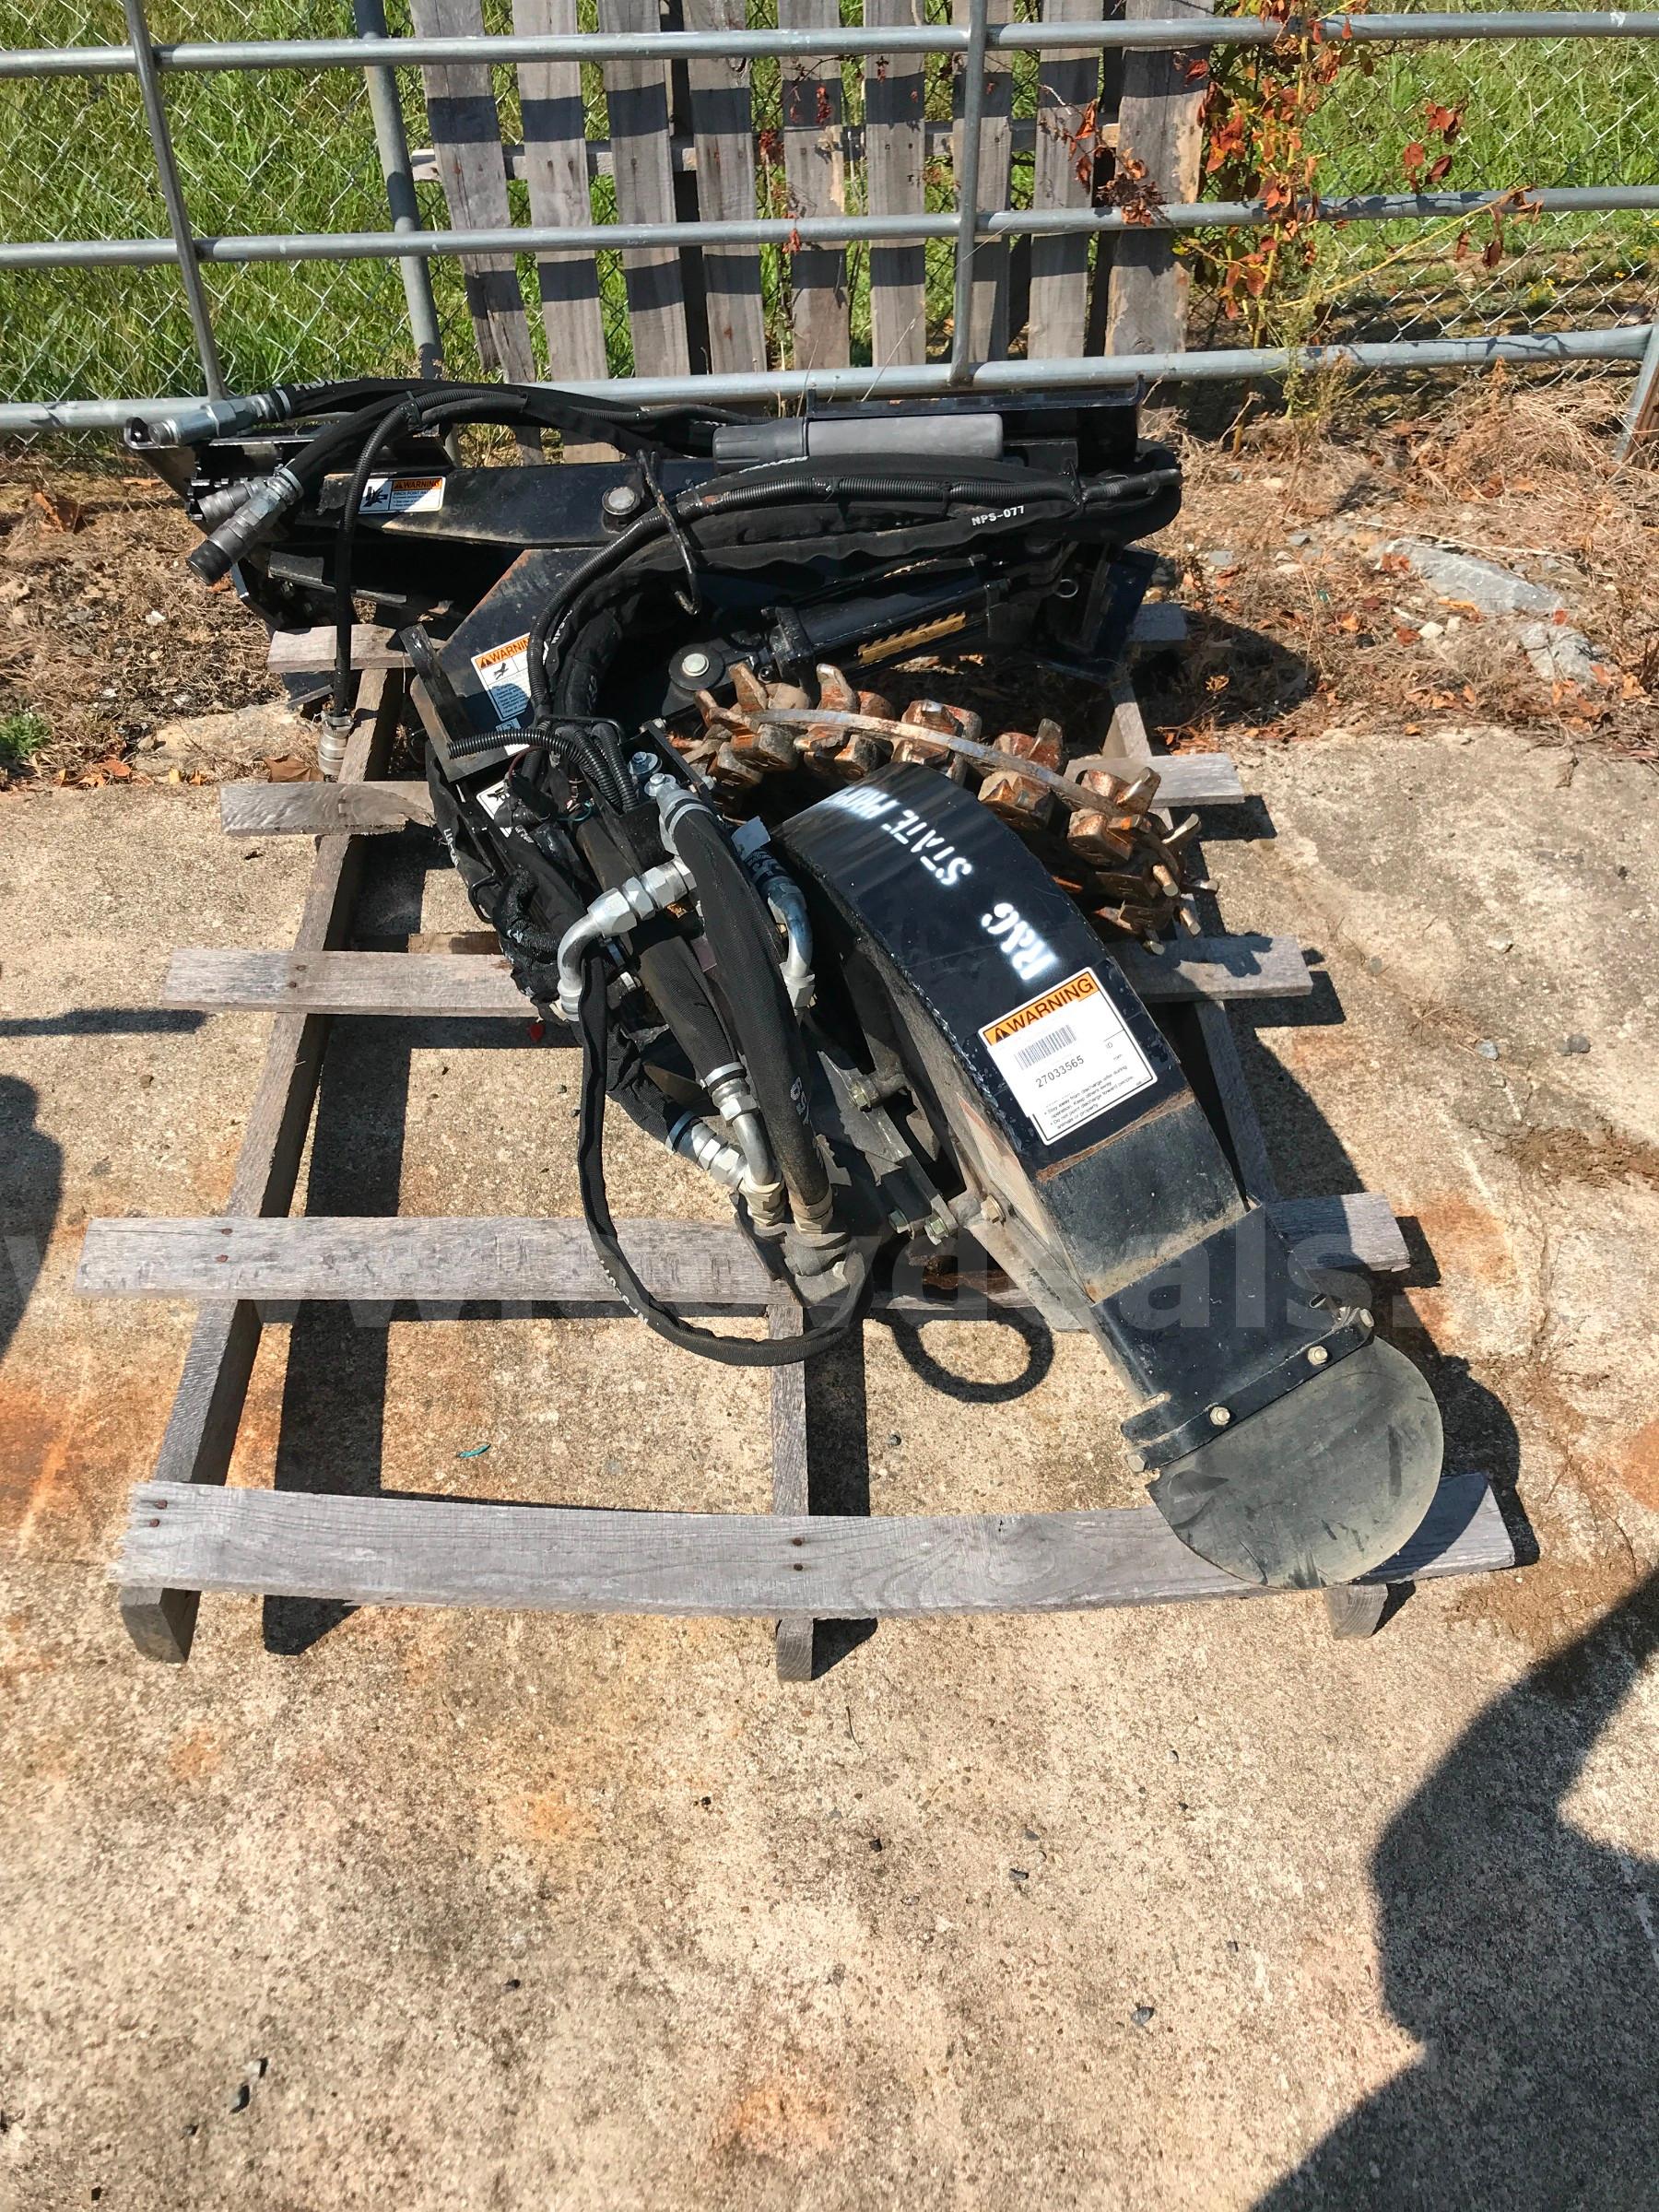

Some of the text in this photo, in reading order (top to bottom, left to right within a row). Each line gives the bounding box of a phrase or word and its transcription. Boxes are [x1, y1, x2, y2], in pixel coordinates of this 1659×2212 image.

[404, 479, 441, 489] WARNING
[971, 505, 1025, 526] NPS-077
[490, 637, 530, 664] WARNIN
[881, 809, 973, 886] STATE
[1006, 978, 1094, 1032] WARNING
[1035, 1054, 1085, 1088] 27033565
